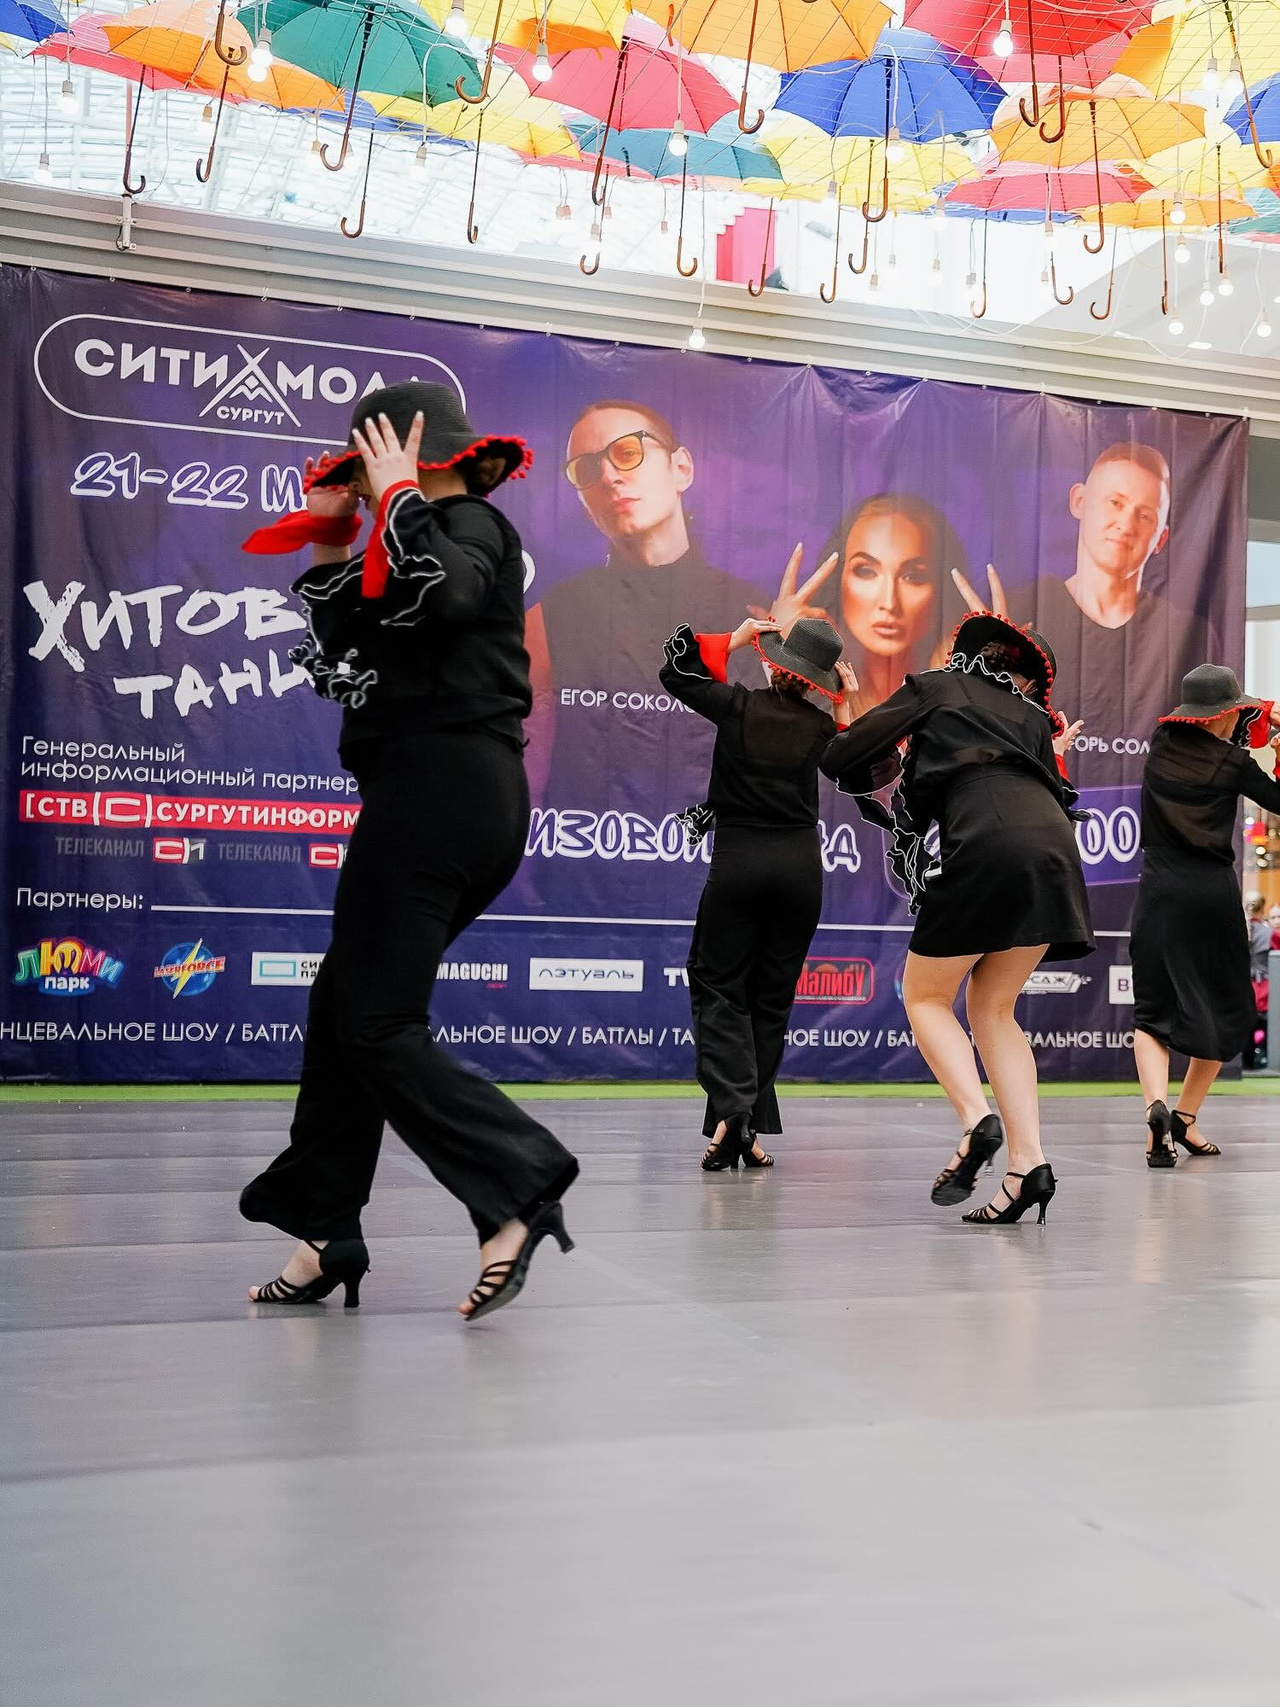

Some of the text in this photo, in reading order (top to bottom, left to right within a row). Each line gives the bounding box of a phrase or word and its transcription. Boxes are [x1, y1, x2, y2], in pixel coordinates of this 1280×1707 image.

[74, 338, 420, 404] СИТИ МОЛ
[216, 405, 285, 426] СУРГУТ
[70, 452, 309, 513] 21-22 М
[560, 688, 608, 708] ЕГОР
[21, 736, 186, 763] Генеральный
[20, 758, 359, 796] информационный партнер
[55, 836, 145, 858] ТЕЛЕКАНАЛ
[217, 843, 302, 865] ТЕЛЕКАНАЛ
[16, 887, 144, 913] Партнеры:
[0, 1021, 156, 1042] НЦЕВАЛЬНОЕ
[162, 1022, 219, 1042] ШОУ
[242, 1023, 308, 1042] БАТТЛ
[429, 1025, 507, 1044] ЛЬНОЕ
[511, 1025, 563, 1045] ШОУ
[582, 1026, 654, 1045] БАТТЛЫ
[823, 1028, 871, 1047] ШОУ
